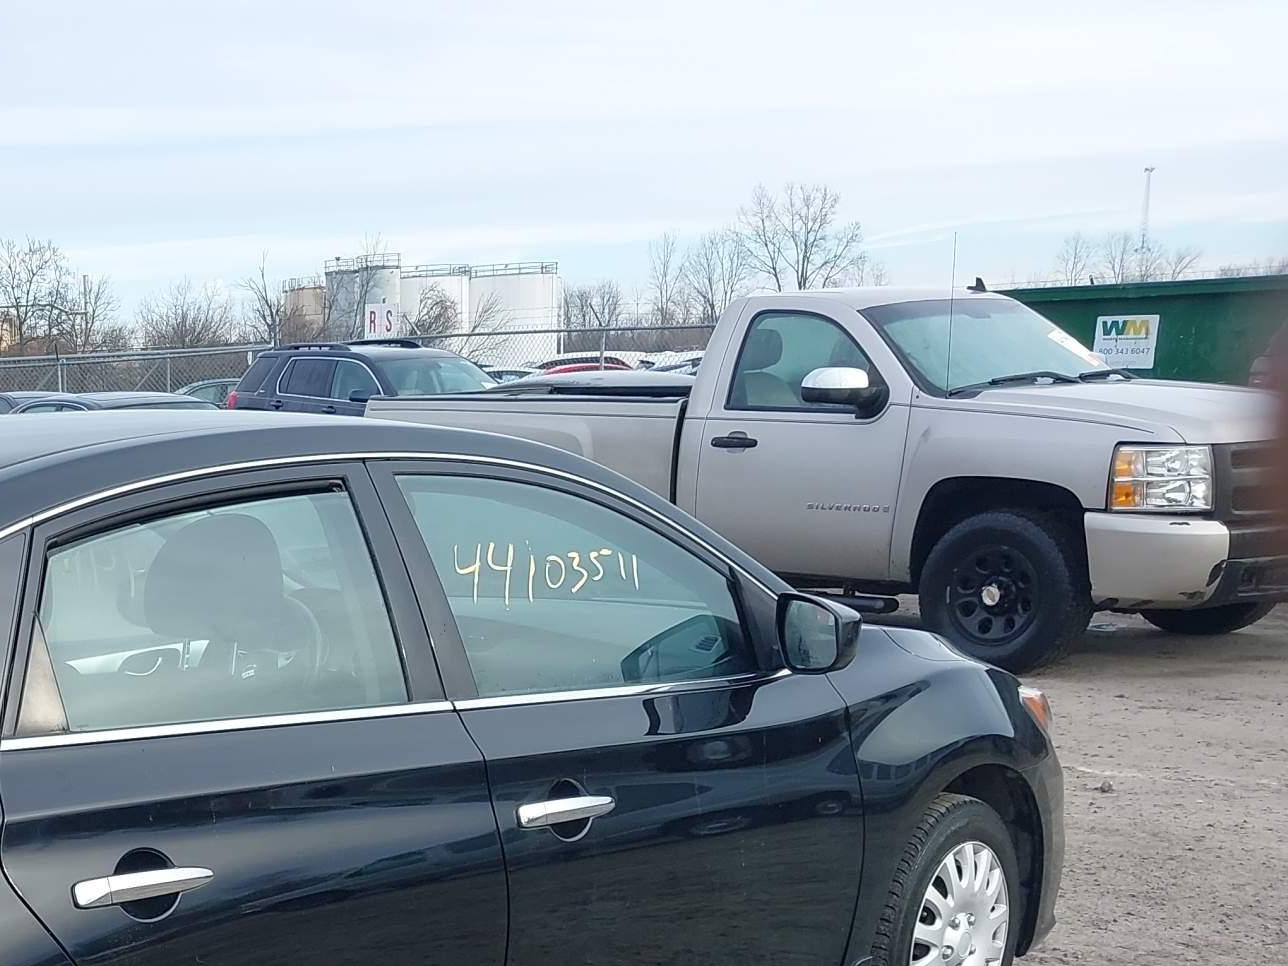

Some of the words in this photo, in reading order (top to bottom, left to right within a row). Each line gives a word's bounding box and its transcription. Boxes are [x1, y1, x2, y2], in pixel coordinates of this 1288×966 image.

[369, 310, 376, 333] R
[385, 309, 393, 332] S
[1102, 319, 1149, 337] WM
[1130, 347, 1151, 355] 6047
[807, 502, 881, 513] SILVERADO
[454, 540, 640, 608] 44103511
